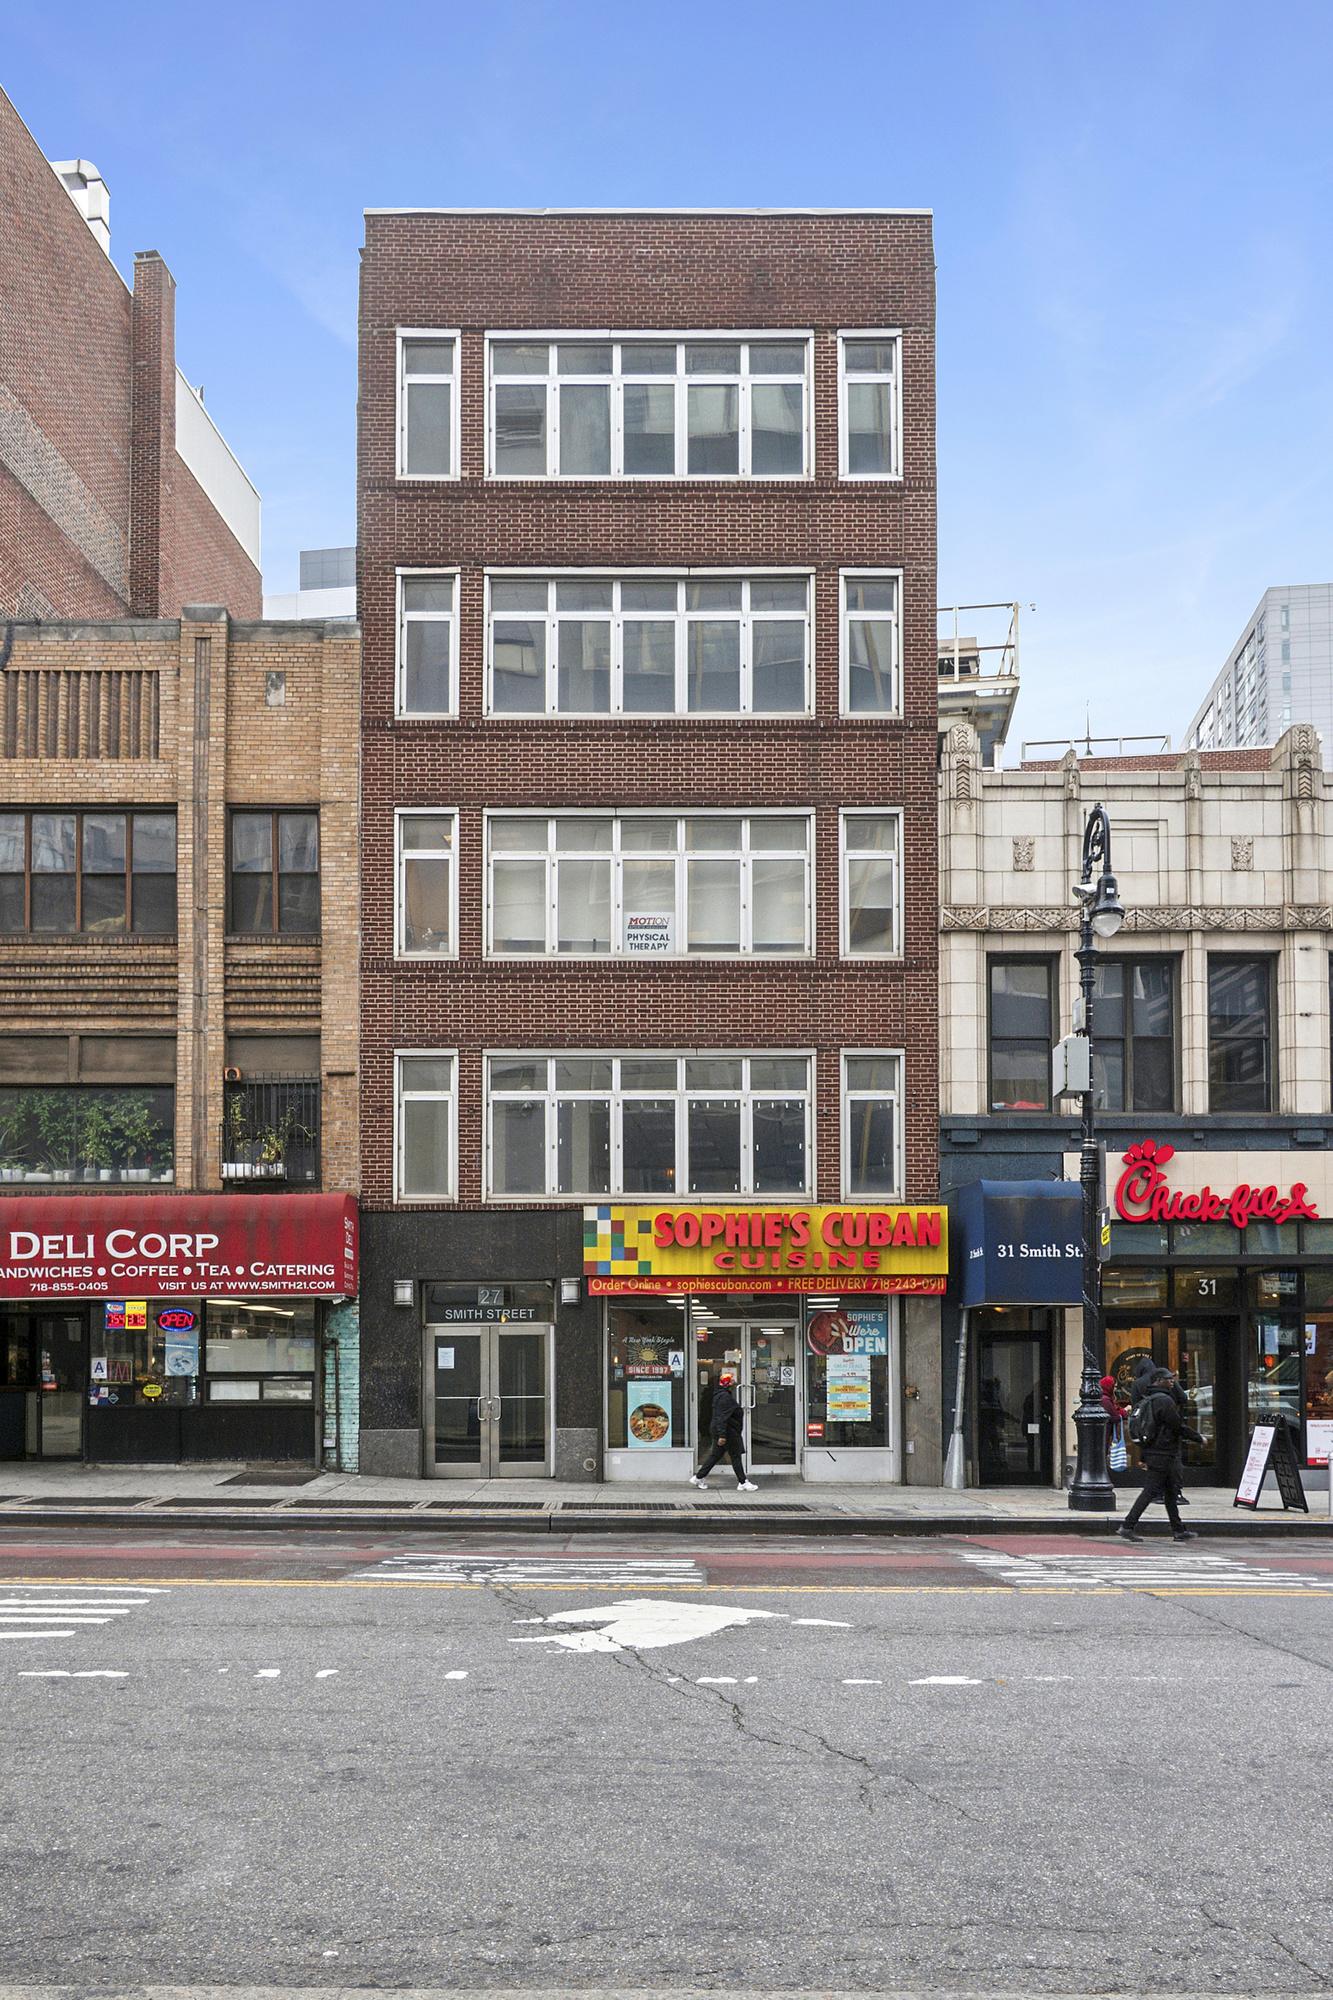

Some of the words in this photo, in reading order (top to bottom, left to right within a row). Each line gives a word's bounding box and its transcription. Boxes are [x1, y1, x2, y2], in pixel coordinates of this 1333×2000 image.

[628, 917, 670, 925] MOTION
[627, 933, 671, 941] PHYSICAL
[629, 942, 669, 950] THERAPY
[1115, 1139, 1320, 1230] Chick-fil-A
[653, 1211, 811, 1248] SOPHIE'S
[822, 1211, 942, 1247] CUBAN
[997, 1244, 1015, 1258] 31
[1019, 1243, 1061, 1258] Smith
[1065, 1243, 1084, 1258] St.
[712, 1251, 882, 1270] CUISINE
[30, 1281, 108, 1292] 718-855-0405
[158, 1281, 187, 1290] VISIT
[191, 1281, 207, 1290] US
[209, 1281, 225, 1290] AT
[226, 1280, 336, 1290] WWW.SMITH21.COM
[591, 1278, 625, 1291] Order
[627, 1277, 662, 1291] Online
[676, 1277, 772, 1294] sophiescuban.com
[788, 1277, 814, 1290] FREE
[816, 1277, 868, 1290] DELIVERY
[871, 1277, 945, 1290] 718-243-0911
[1198, 1279, 1217, 1296] 31
[480, 1289, 501, 1305] 27
[159, 1313, 194, 1328] OPEN
[444, 1308, 483, 1320] SMITH
[486, 1308, 535, 1319] STREET
[846, 1313, 884, 1322] SOPHIE'S
[843, 1336, 886, 1353] OPEN
[671, 1354, 681, 1365] A
[94, 1361, 104, 1374] A
[628, 1366, 650, 1374] SINCE
